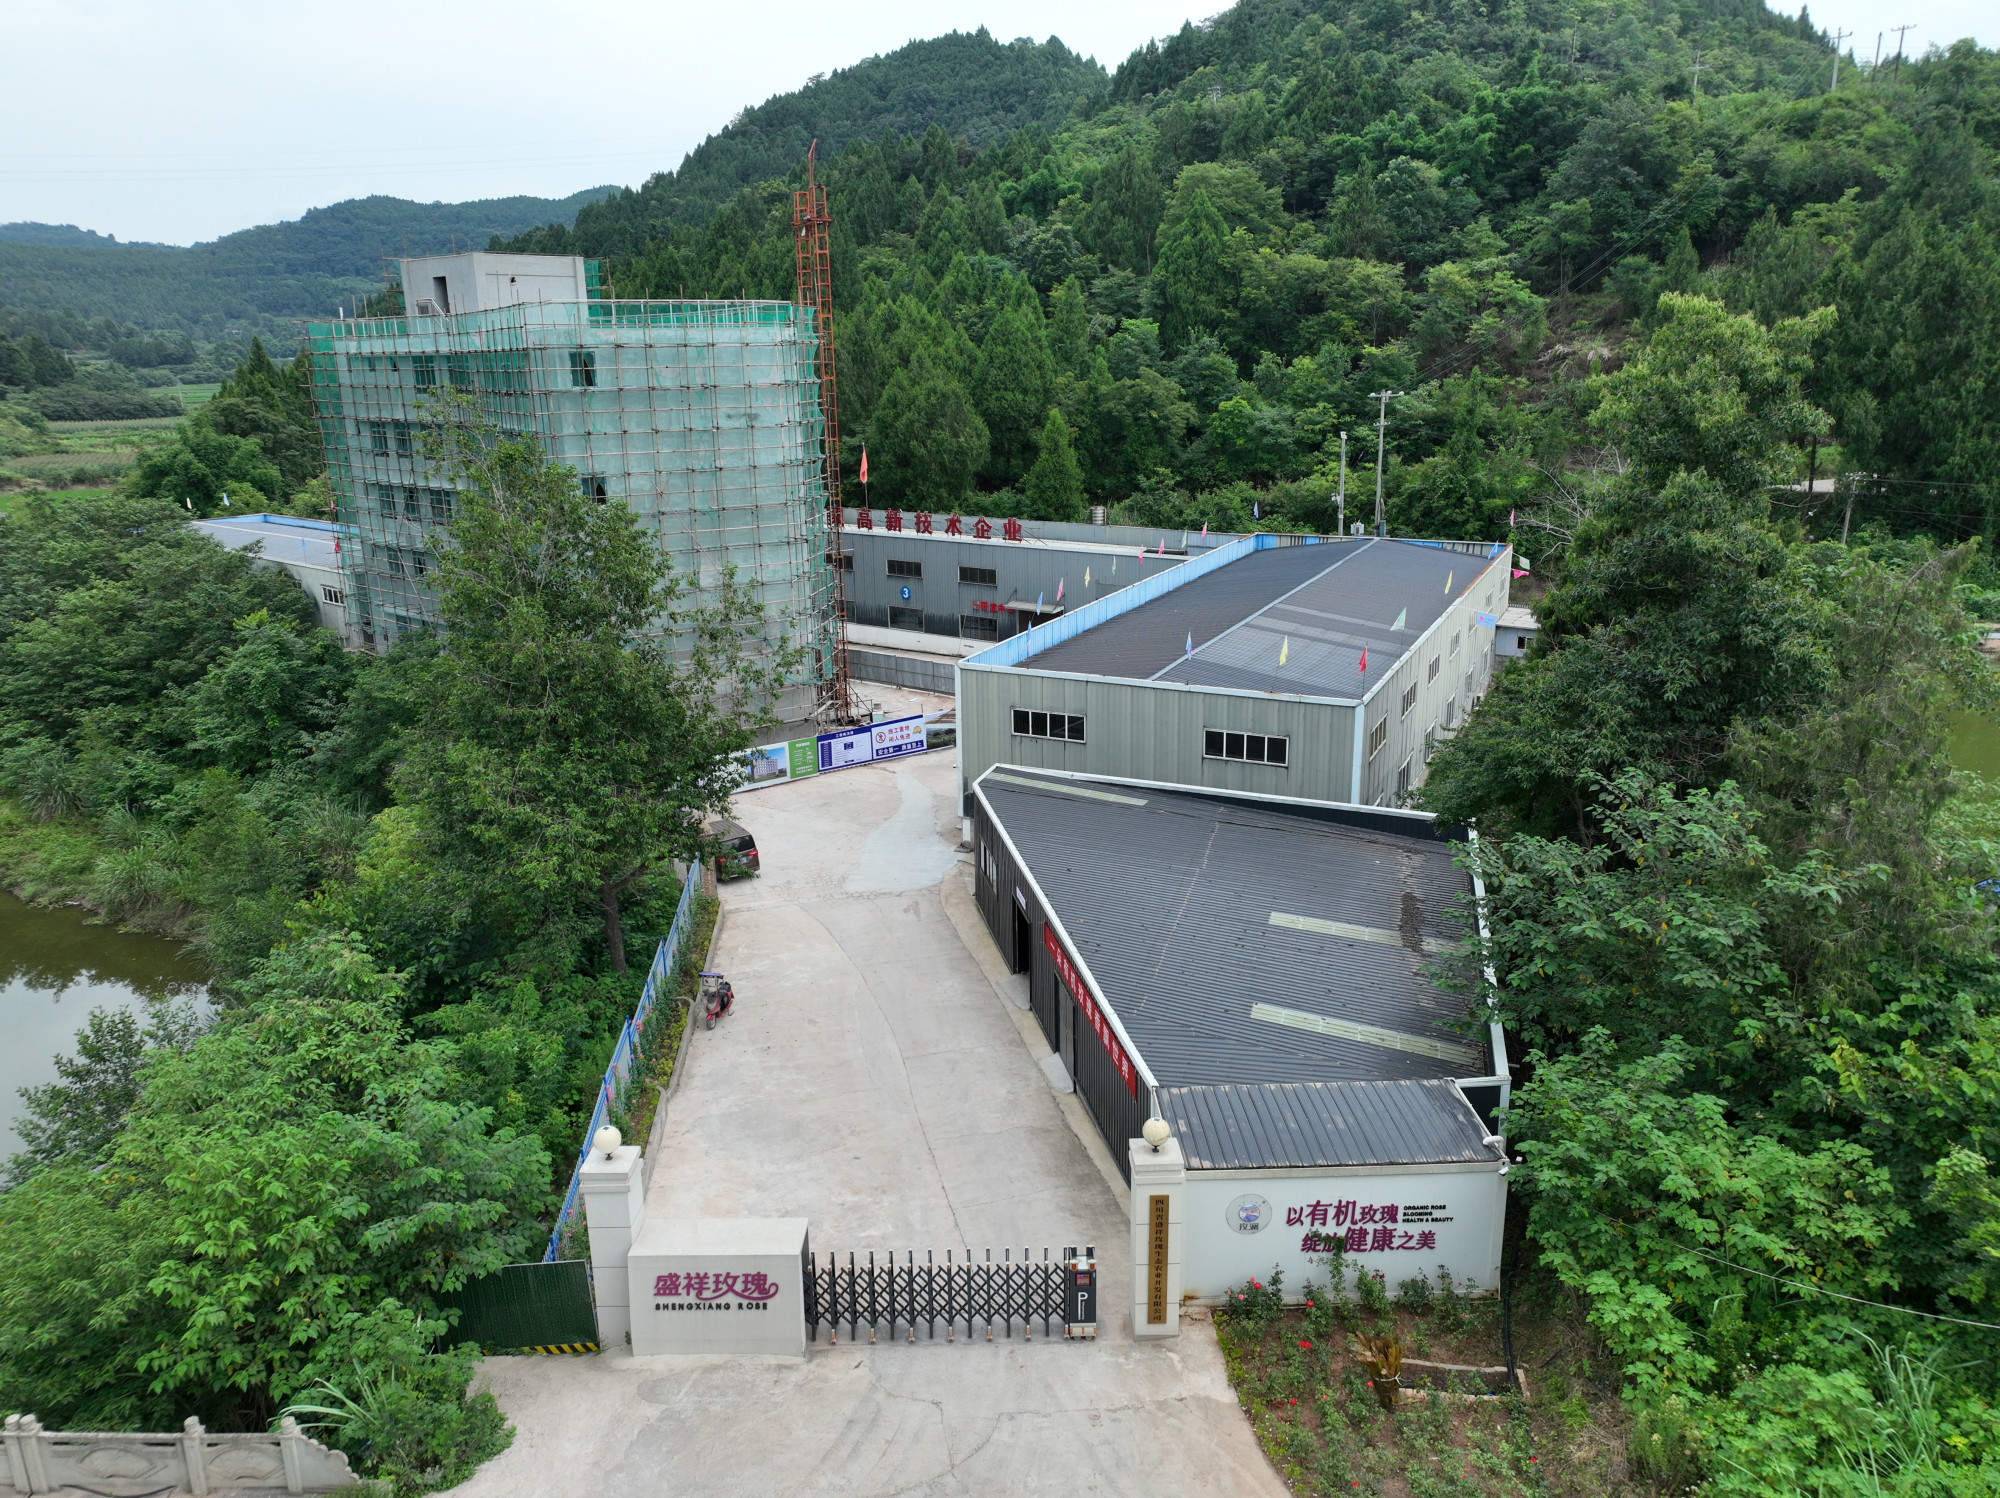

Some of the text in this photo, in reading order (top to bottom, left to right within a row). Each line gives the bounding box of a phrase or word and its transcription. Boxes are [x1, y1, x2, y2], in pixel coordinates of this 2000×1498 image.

[902, 587, 909, 598] 3
[1286, 1199, 1399, 1227] 以有机玫瑰
[1153, 1199, 1164, 1321] 四川省盛祥玫瑰生态农业开发有限公司
[653, 1271, 779, 1301] 盛祥玫瑰
[655, 1302, 768, 1311] SHENGXIANG ROSE
